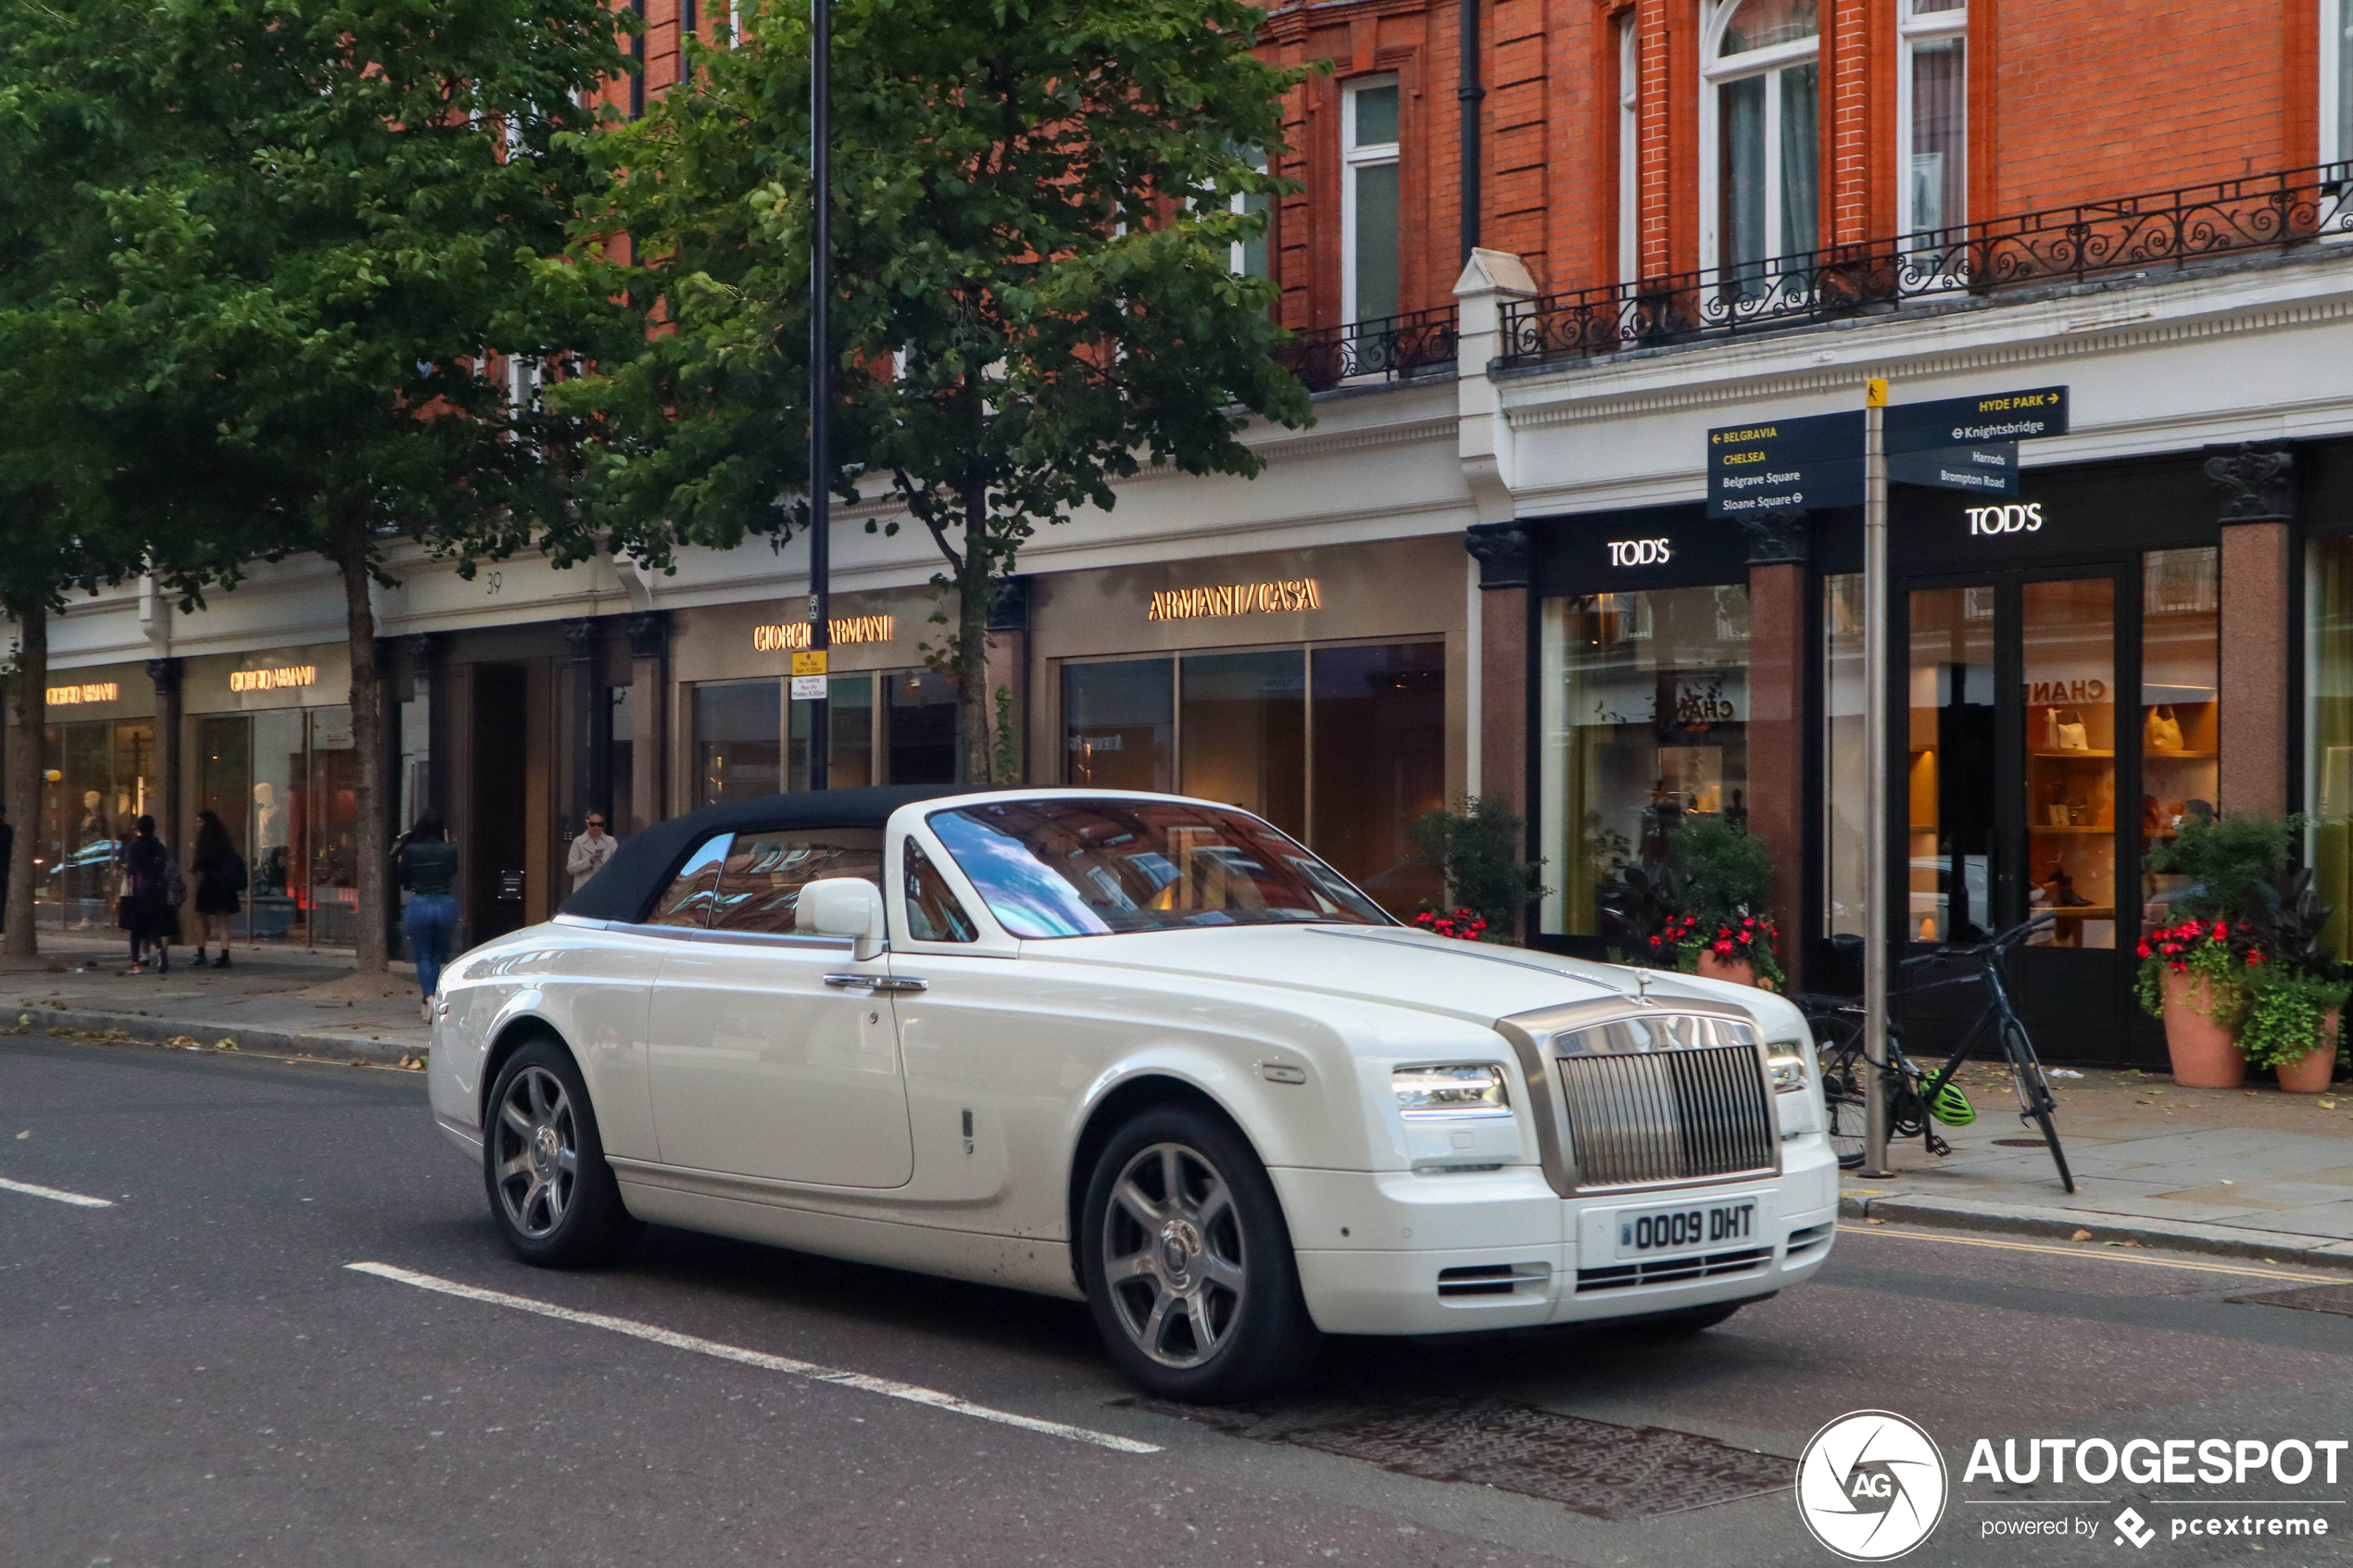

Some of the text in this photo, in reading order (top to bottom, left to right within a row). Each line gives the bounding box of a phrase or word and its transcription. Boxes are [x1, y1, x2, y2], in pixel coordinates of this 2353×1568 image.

[1979, 395, 2045, 412] HYDE PARK
[1723, 427, 1778, 443] BELGRAVIA
[1964, 420, 2045, 439] Knightsbridge
[1723, 451, 1766, 465] CHELSEA
[1972, 451, 2006, 466] Harrods
[1723, 471, 1801, 489] Belgrave Square
[1941, 470, 2005, 488] Brompton Road
[1723, 495, 1792, 510] Sloane Square
[1965, 503, 2042, 535] TOD'S
[486, 571, 502, 595] 39
[1710, 1204, 1755, 1241] DHT
